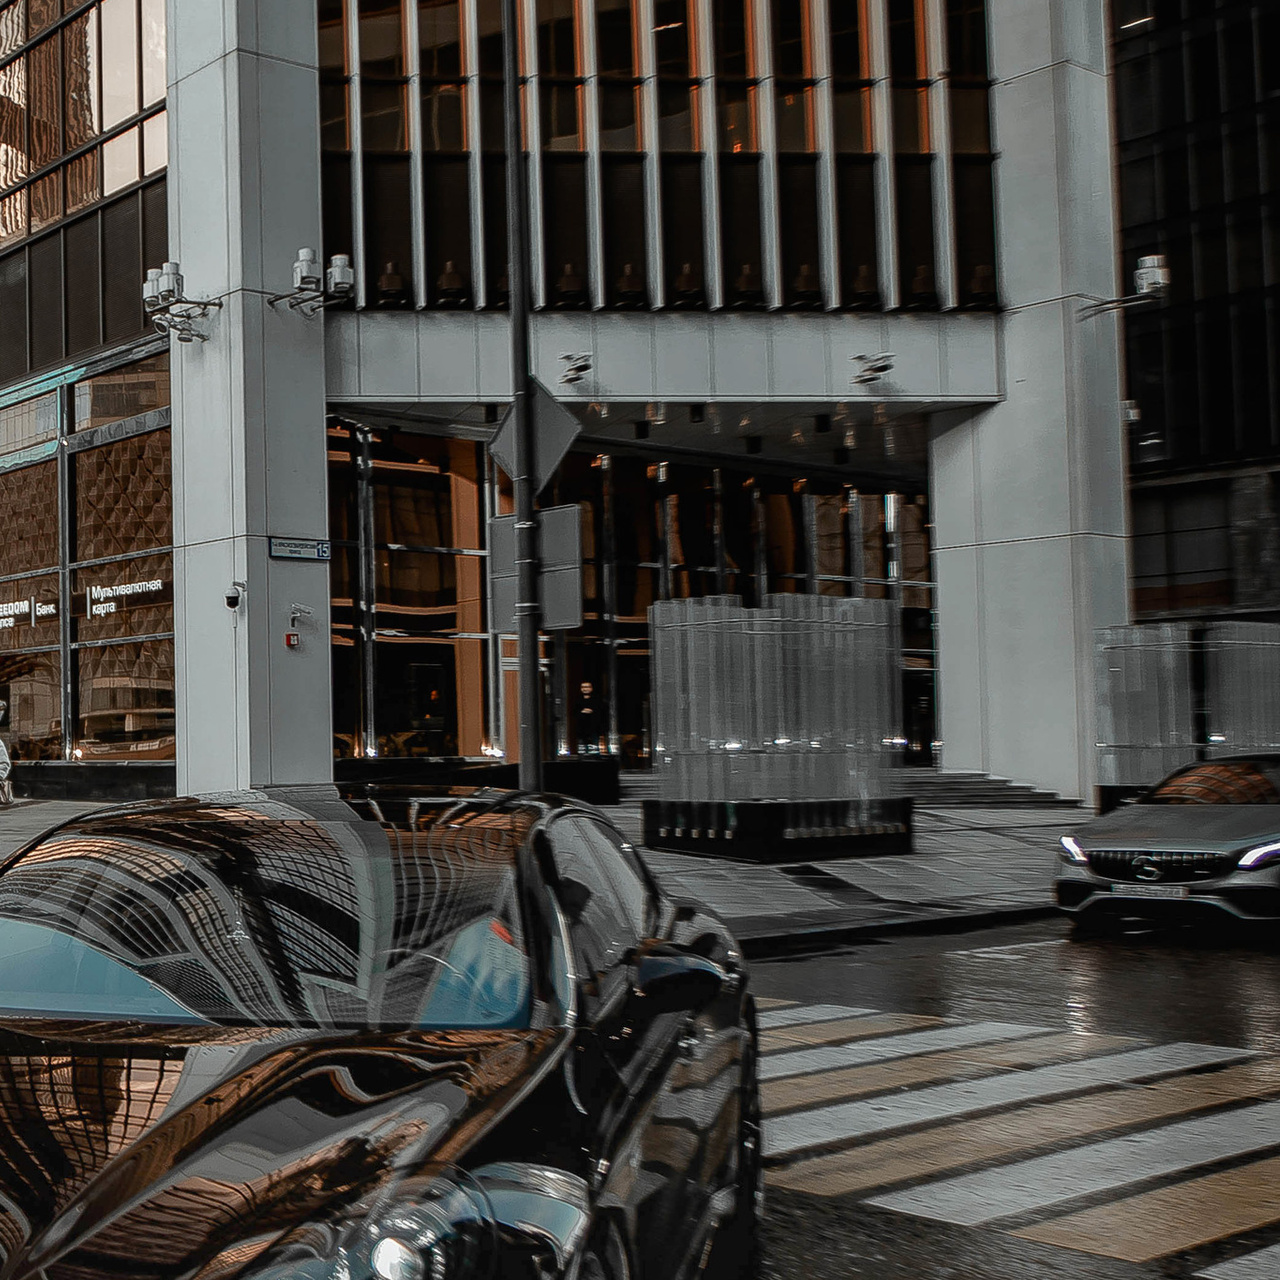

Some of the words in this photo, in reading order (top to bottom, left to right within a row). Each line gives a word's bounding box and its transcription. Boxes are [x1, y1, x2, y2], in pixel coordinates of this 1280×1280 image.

[317, 543, 329, 557] 15
[91, 580, 163, 601] Мультивалютная
[35, 602, 57, 616] Банк
[92, 602, 116, 617] карта
